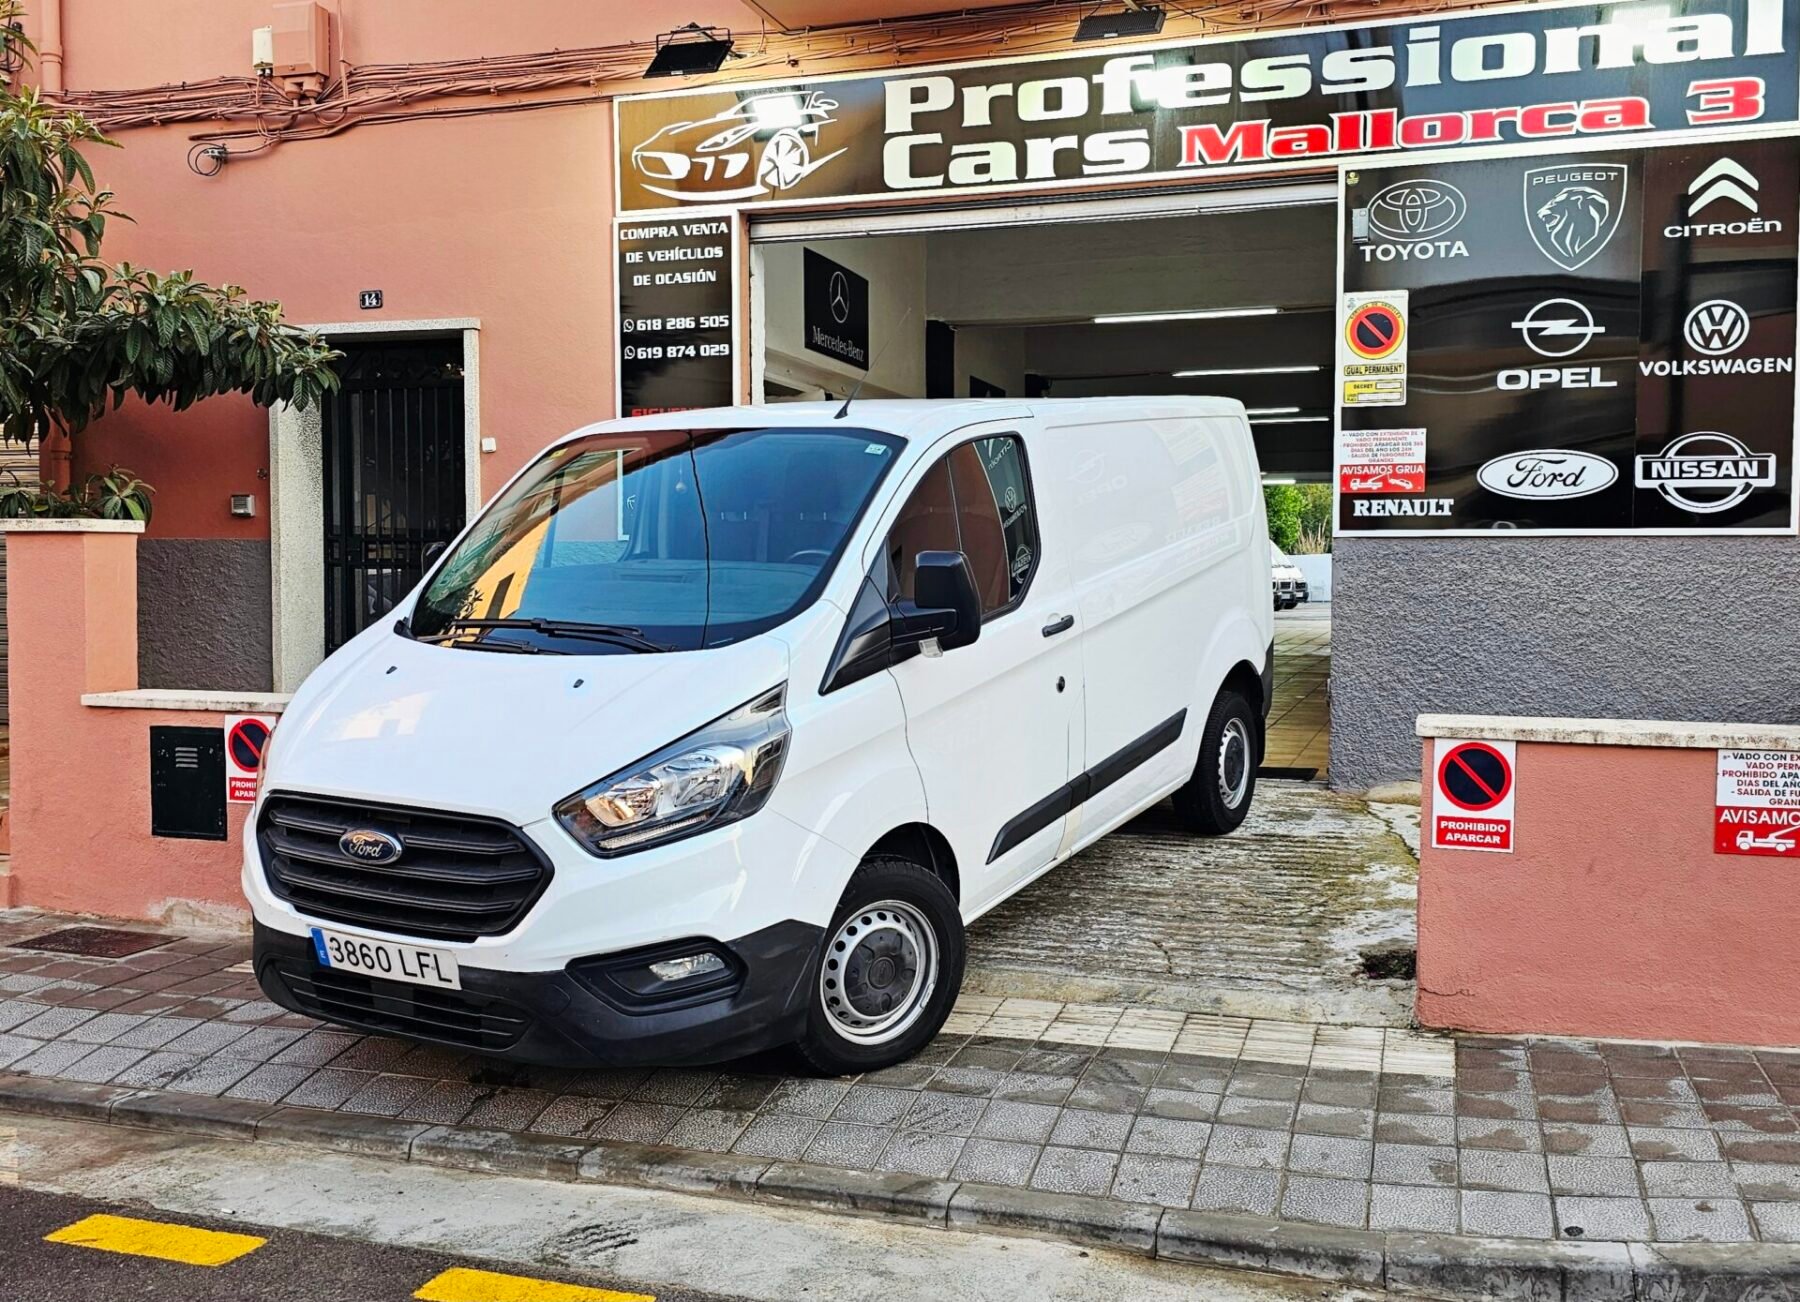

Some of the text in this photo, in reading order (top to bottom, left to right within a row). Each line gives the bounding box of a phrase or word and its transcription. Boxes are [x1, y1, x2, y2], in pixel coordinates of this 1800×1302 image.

[883, 0, 1785, 134] Professional
[883, 76, 1766, 190] Cars Mallorca 3
[1532, 172, 1618, 186] PEUGEOT
[620, 222, 729, 240] COMPRA VENTA
[625, 246, 724, 264] DE VEHÍCULOS
[1359, 240, 1470, 263] TOYOTA
[633, 269, 717, 287] DE OCASIÓN
[364, 293, 378, 307] 14
[636, 315, 729, 331] 618 286 505
[637, 343, 730, 359] 619 874 029
[812, 325, 864, 362] Mercedes-Benz
[1346, 364, 1402, 375] GUAL PERMANENT
[1639, 357, 1793, 377] VOLKSWAGEN
[1496, 366, 1618, 391] OPEL
[1341, 465, 1424, 475] AVISAMOS GRUA
[1506, 458, 1586, 488] Ford
[1651, 460, 1759, 479] NISSAN
[1353, 498, 1454, 516] RENAULT
[1732, 752, 1760, 760] VADO
[1764, 753, 1787, 761] CON
[1722, 770, 1777, 779] PROHIBIDO
[1737, 779, 1760, 787] DIAS
[1763, 780, 1780, 788] DEL
[1737, 788, 1771, 796] SALIDA
[1774, 789, 1786, 797] DE
[1440, 820, 1507, 833] PROHIBIDO
[349, 835, 383, 857] Ford
[1445, 832, 1501, 844] APARCAR
[329, 936, 452, 983] 3860 LFL
